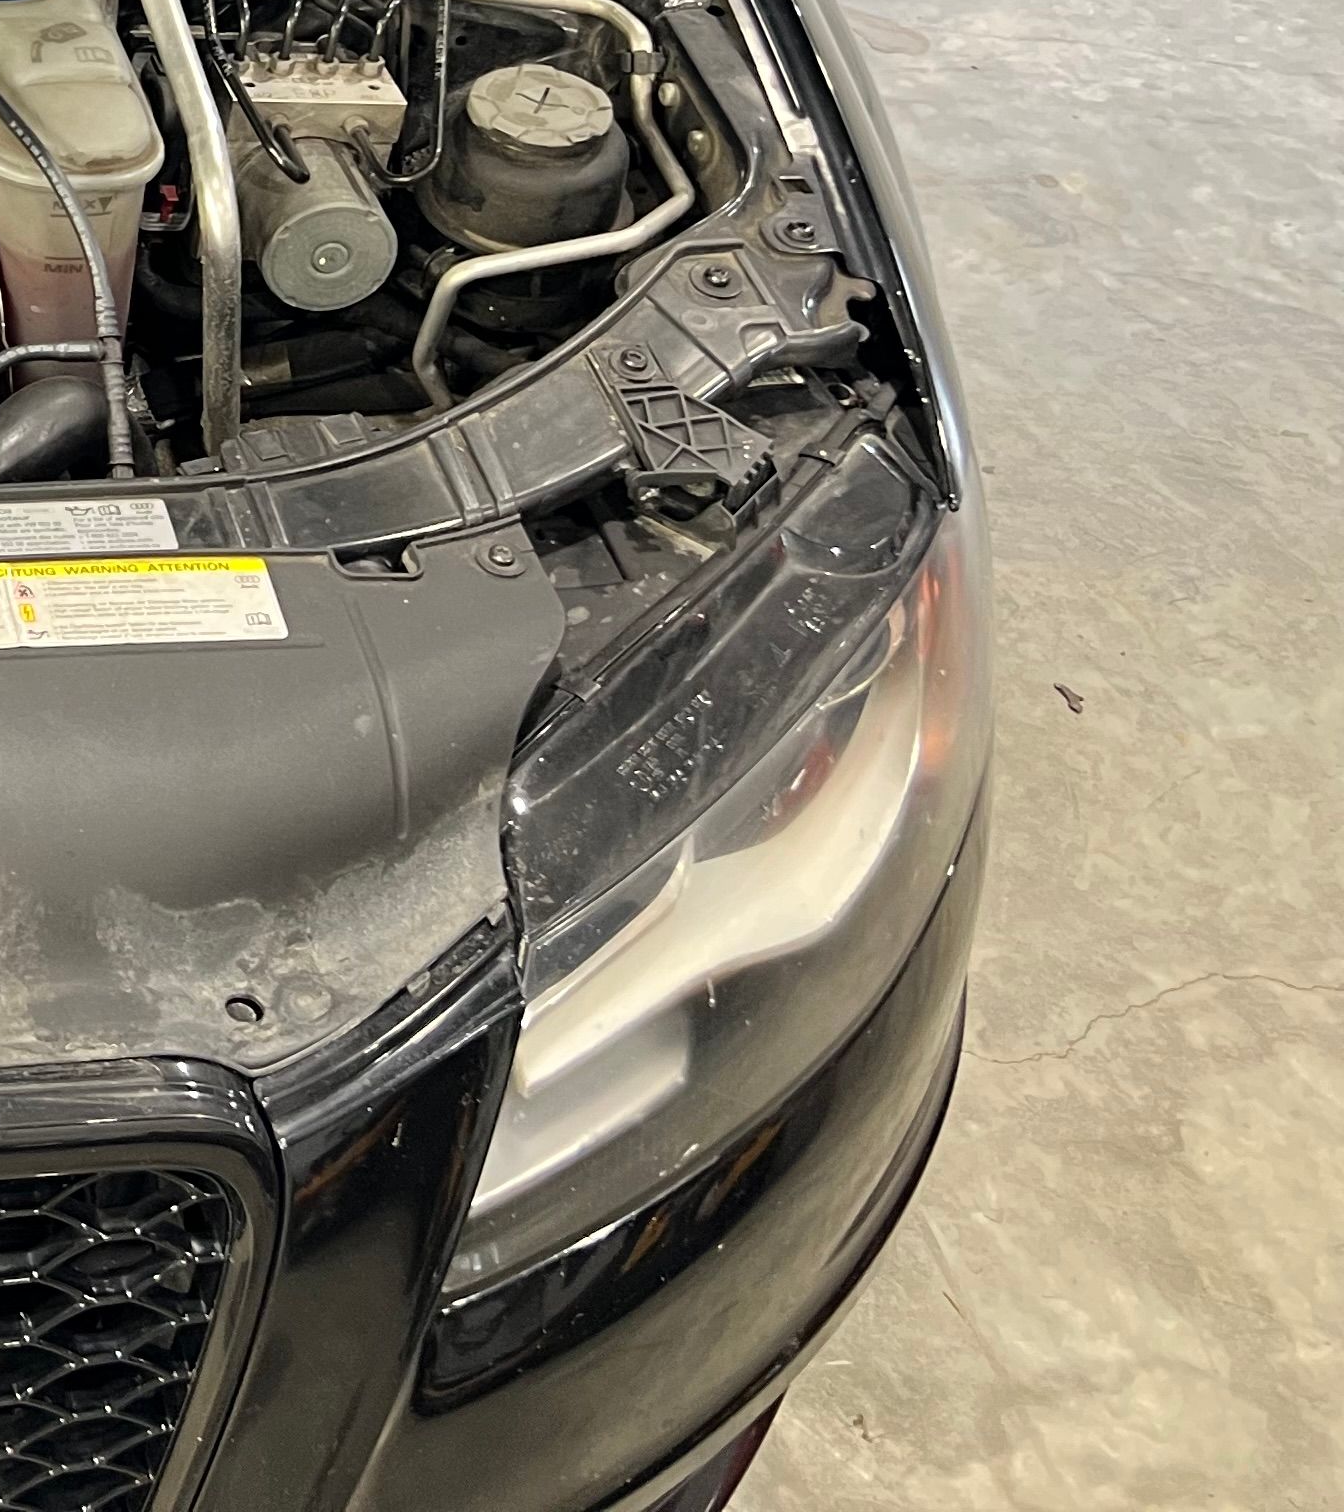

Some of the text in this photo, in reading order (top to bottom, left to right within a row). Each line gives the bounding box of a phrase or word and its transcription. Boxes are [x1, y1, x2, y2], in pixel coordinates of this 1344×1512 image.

[53, 199, 96, 211] MX
[44, 264, 83, 274] MIN
[64, 564, 139, 575] WARNING
[148, 562, 230, 572] ATTENTION
